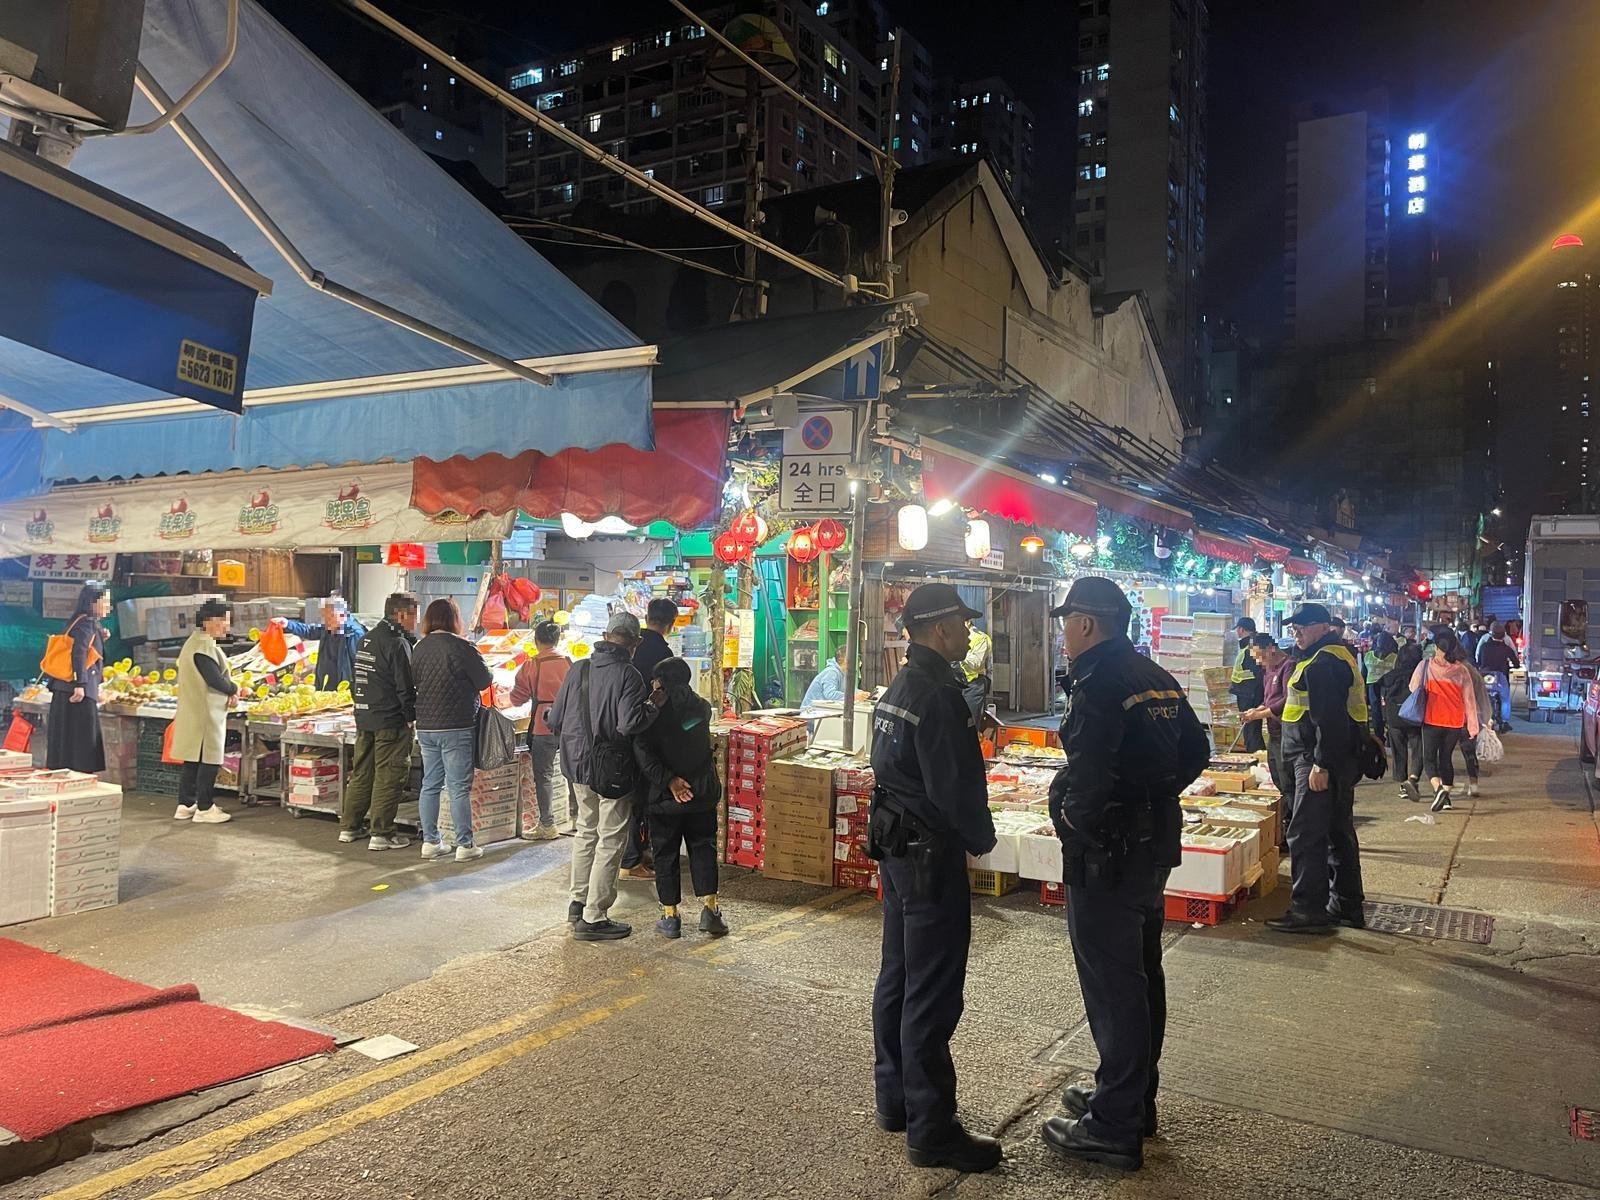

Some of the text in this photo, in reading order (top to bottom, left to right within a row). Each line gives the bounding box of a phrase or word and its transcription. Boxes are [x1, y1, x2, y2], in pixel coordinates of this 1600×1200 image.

[187, 360, 210, 383] 5623
[789, 462, 844, 477] 24 hrs
[793, 482, 836, 504] 全日
